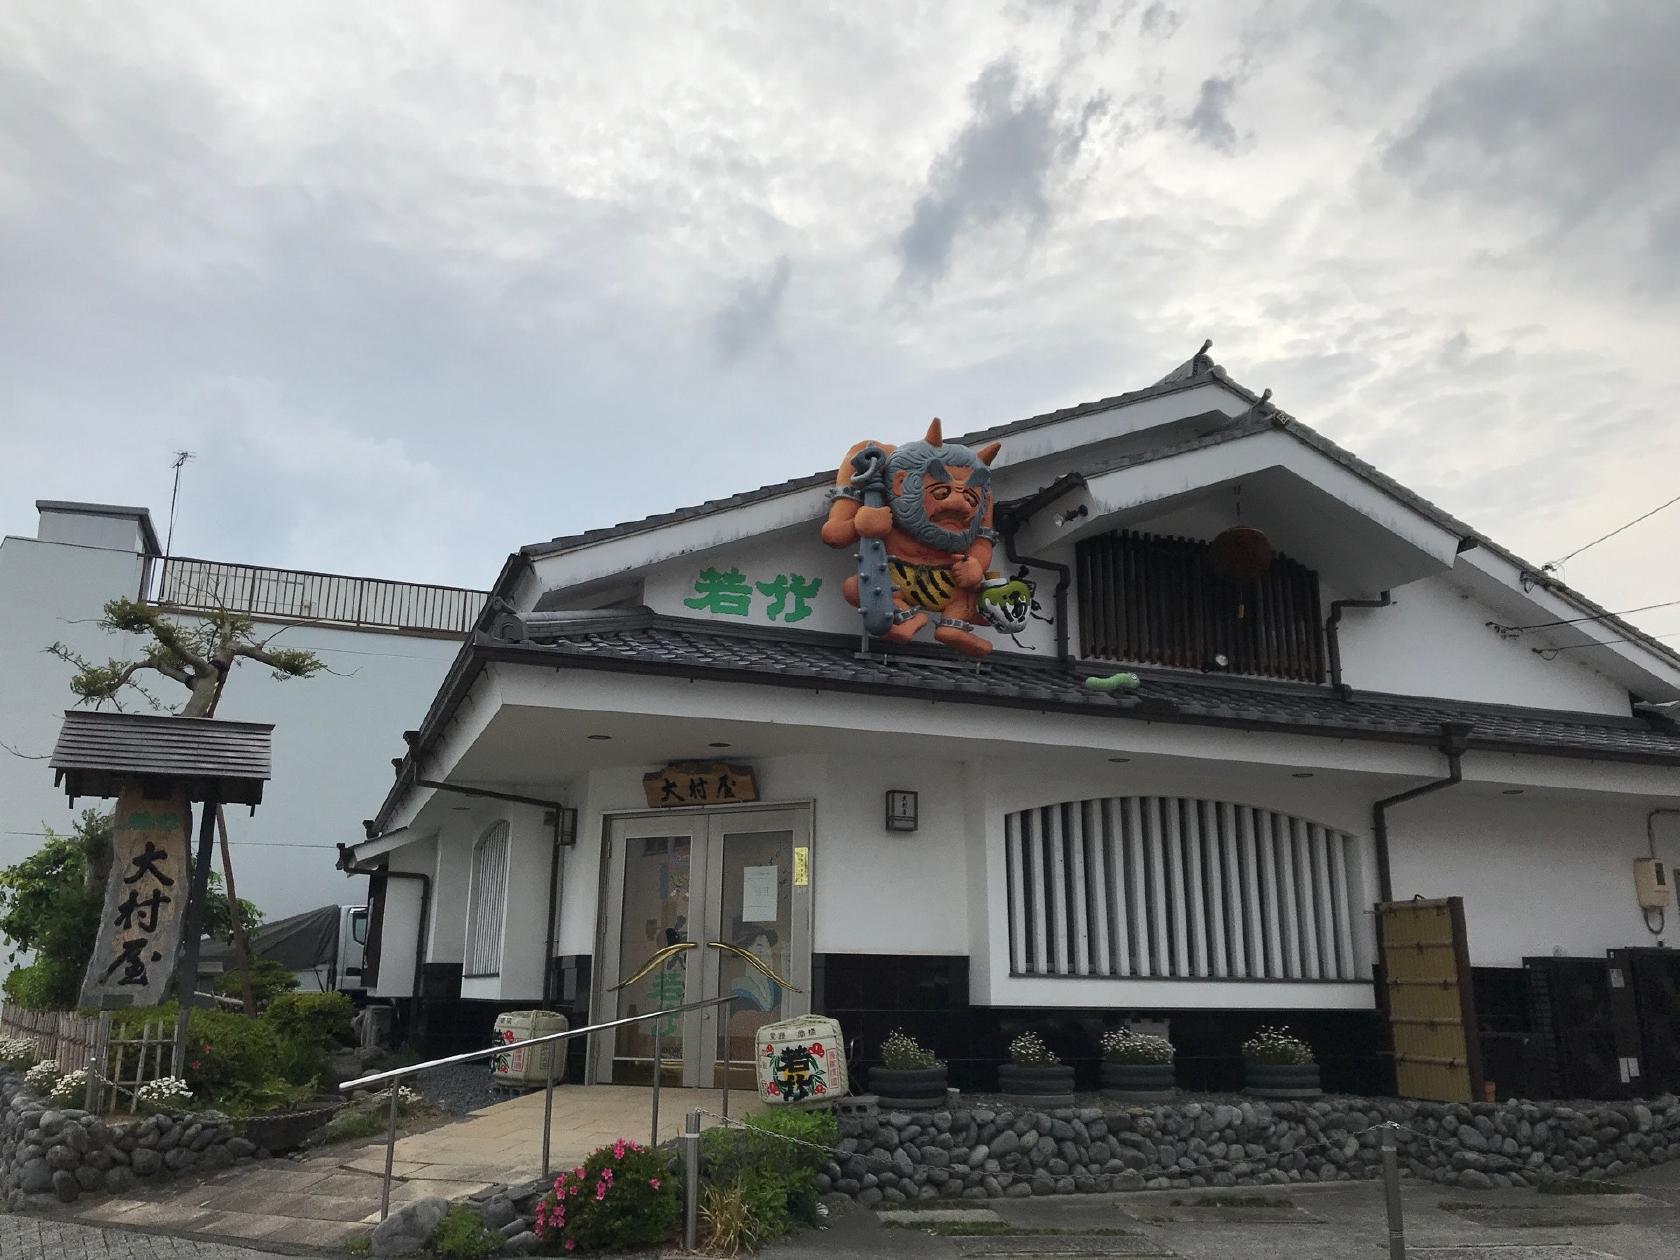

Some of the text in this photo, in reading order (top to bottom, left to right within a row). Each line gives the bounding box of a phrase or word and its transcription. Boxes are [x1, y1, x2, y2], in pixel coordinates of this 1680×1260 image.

[683, 566, 823, 623] 若竹
[660, 773, 737, 802] 大村屋
[98, 841, 175, 987] 大村屋
